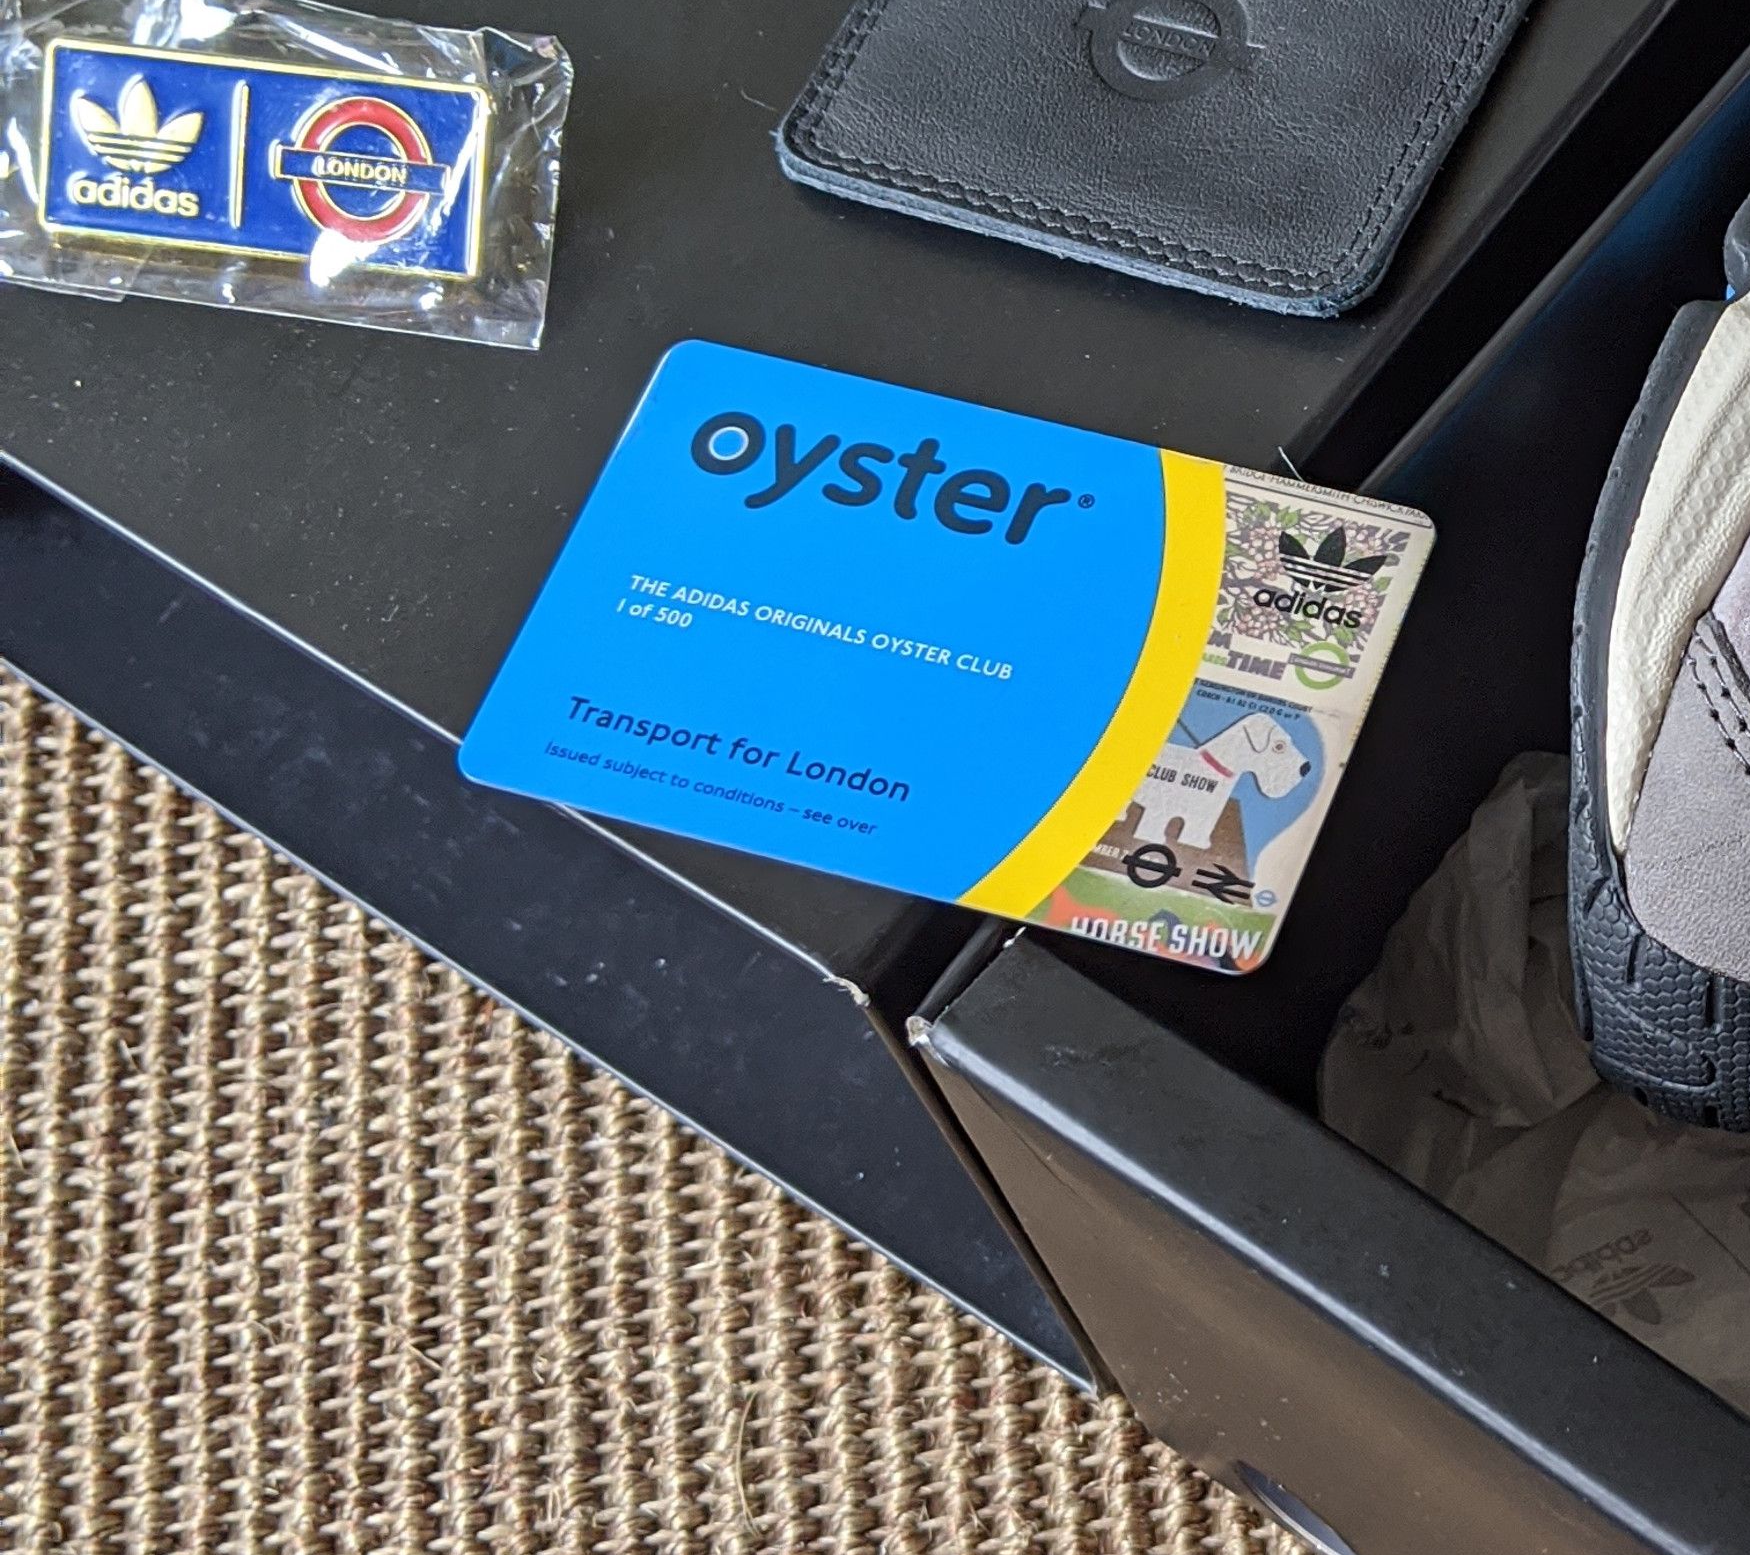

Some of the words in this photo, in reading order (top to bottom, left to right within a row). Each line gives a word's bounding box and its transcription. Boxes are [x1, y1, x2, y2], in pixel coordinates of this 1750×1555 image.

[311, 155, 408, 184] LONDON
[70, 172, 200, 219] adidas
[628, 603, 655, 618] of
[654, 607, 693, 628] 500
[631, 574, 671, 598] THE
[671, 586, 751, 617] ADIDAS
[754, 605, 868, 645] ORIGINALS
[871, 633, 952, 666] OYSTER
[956, 654, 1013, 680] CLUB
[1253, 587, 1363, 629] adidas
[1226, 650, 1288, 681] TIME
[567, 695, 722, 756] Transport
[729, 736, 781, 769] for
[786, 750, 911, 803] London
[544, 740, 600, 767] Issued
[603, 756, 667, 784] subject
[670, 772, 689, 789] to
[693, 779, 785, 813] conditions
[802, 805, 833, 825] see
[836, 814, 878, 836] over
[1146, 763, 1177, 783] CLUB
[1181, 772, 1219, 794] SHOW
[1168, 924, 1263, 960] SHOW
